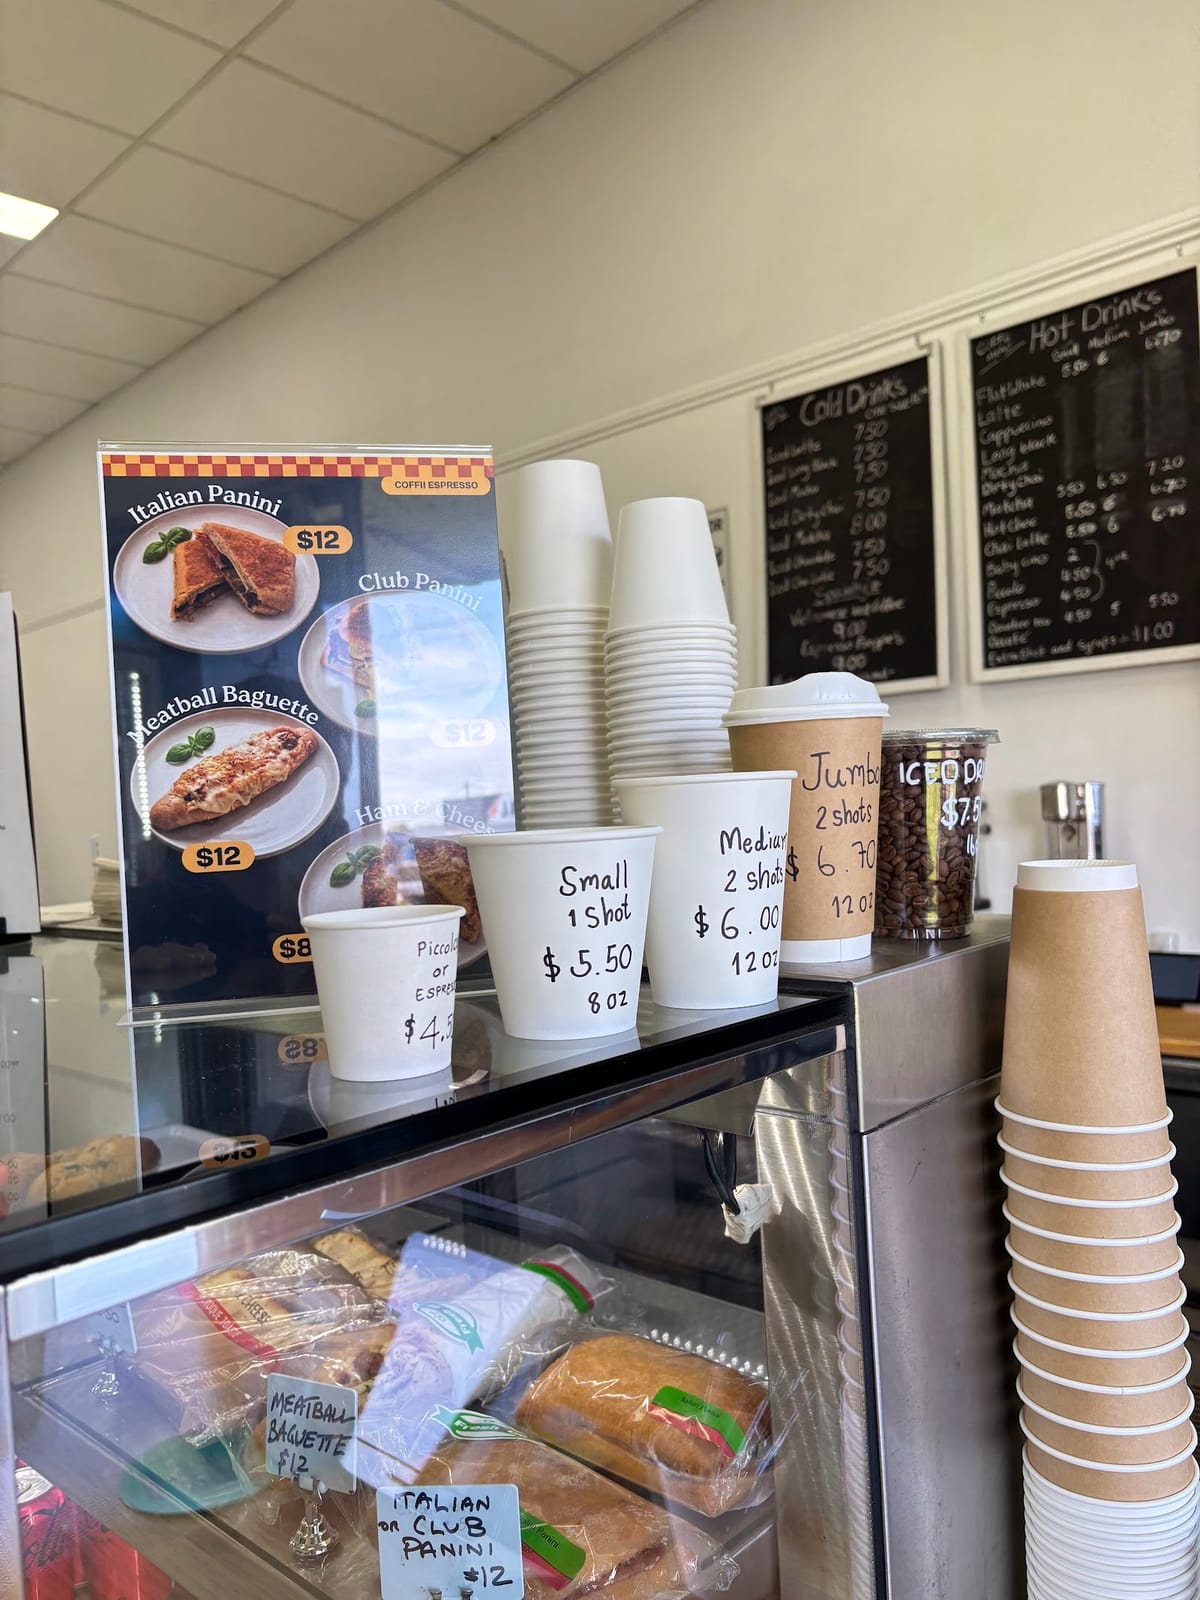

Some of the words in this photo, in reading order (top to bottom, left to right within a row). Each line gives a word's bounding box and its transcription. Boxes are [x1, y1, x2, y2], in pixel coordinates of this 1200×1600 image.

[1029, 313, 1075, 354] Hot
[799, 390, 843, 427] Cold
[977, 402, 1023, 428] Latte
[980, 446, 1016, 467] Long
[394, 480, 426, 490] COFFII
[428, 480, 479, 490] ESPRESSO
[127, 486, 204, 525] Italian
[208, 484, 284, 517] Panini
[296, 528, 340, 551] $12
[357, 570, 409, 592] Club
[413, 571, 484, 612] Panini
[126, 686, 218, 744] Meatball
[222, 685, 320, 727] Baguette
[445, 722, 486, 743] $12
[356, 801, 406, 826] Ham
[435, 800, 496, 834] Chees
[816, 806, 827, 829] 2
[832, 798, 872, 827] shots
[196, 846, 242, 867] $12
[559, 860, 628, 897] Small
[724, 869, 737, 892] 2
[747, 858, 783, 891] shots
[279, 938, 311, 960] $8
[432, 964, 449, 978] or
[271, 1392, 356, 1425] MEATBALL
[267, 1419, 351, 1457] BAGUETTE
[393, 1492, 491, 1513] ITALIAN
[413, 1515, 487, 1539] CLUB
[402, 1536, 493, 1561] PANINI
